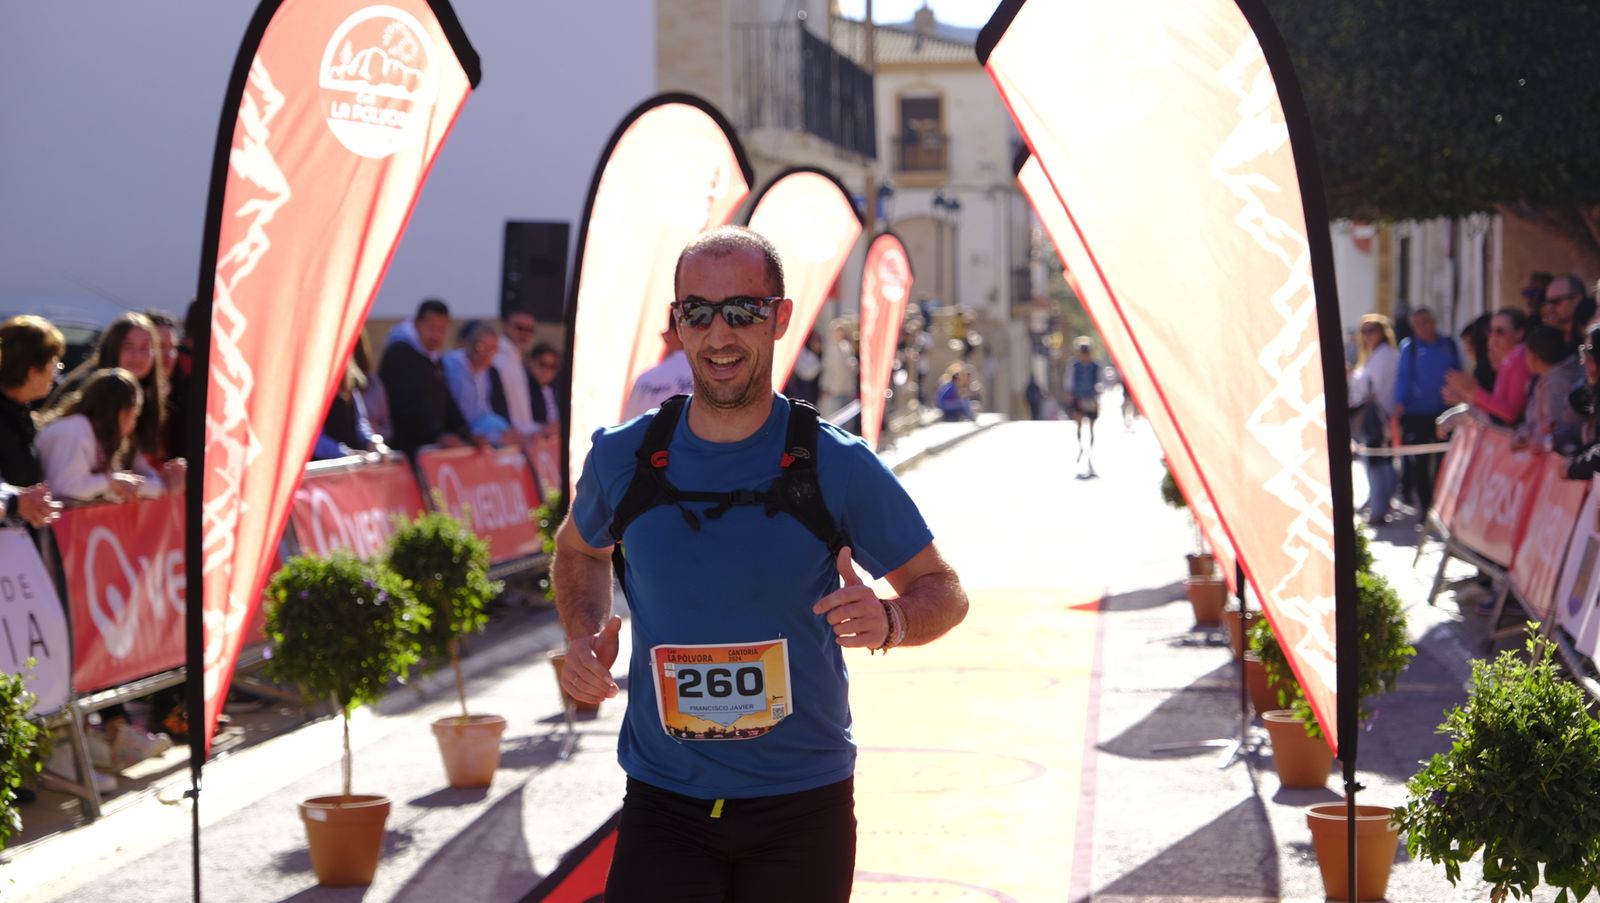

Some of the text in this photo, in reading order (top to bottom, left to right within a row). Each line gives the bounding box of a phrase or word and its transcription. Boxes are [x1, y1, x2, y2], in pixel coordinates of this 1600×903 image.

[351, 104, 410, 130] POLVO
[728, 648, 759, 656] CANTORIA
[667, 654, 676, 662] LA
[677, 666, 764, 699] 260
[689, 703, 755, 712] FRANCISCO JAVIER
